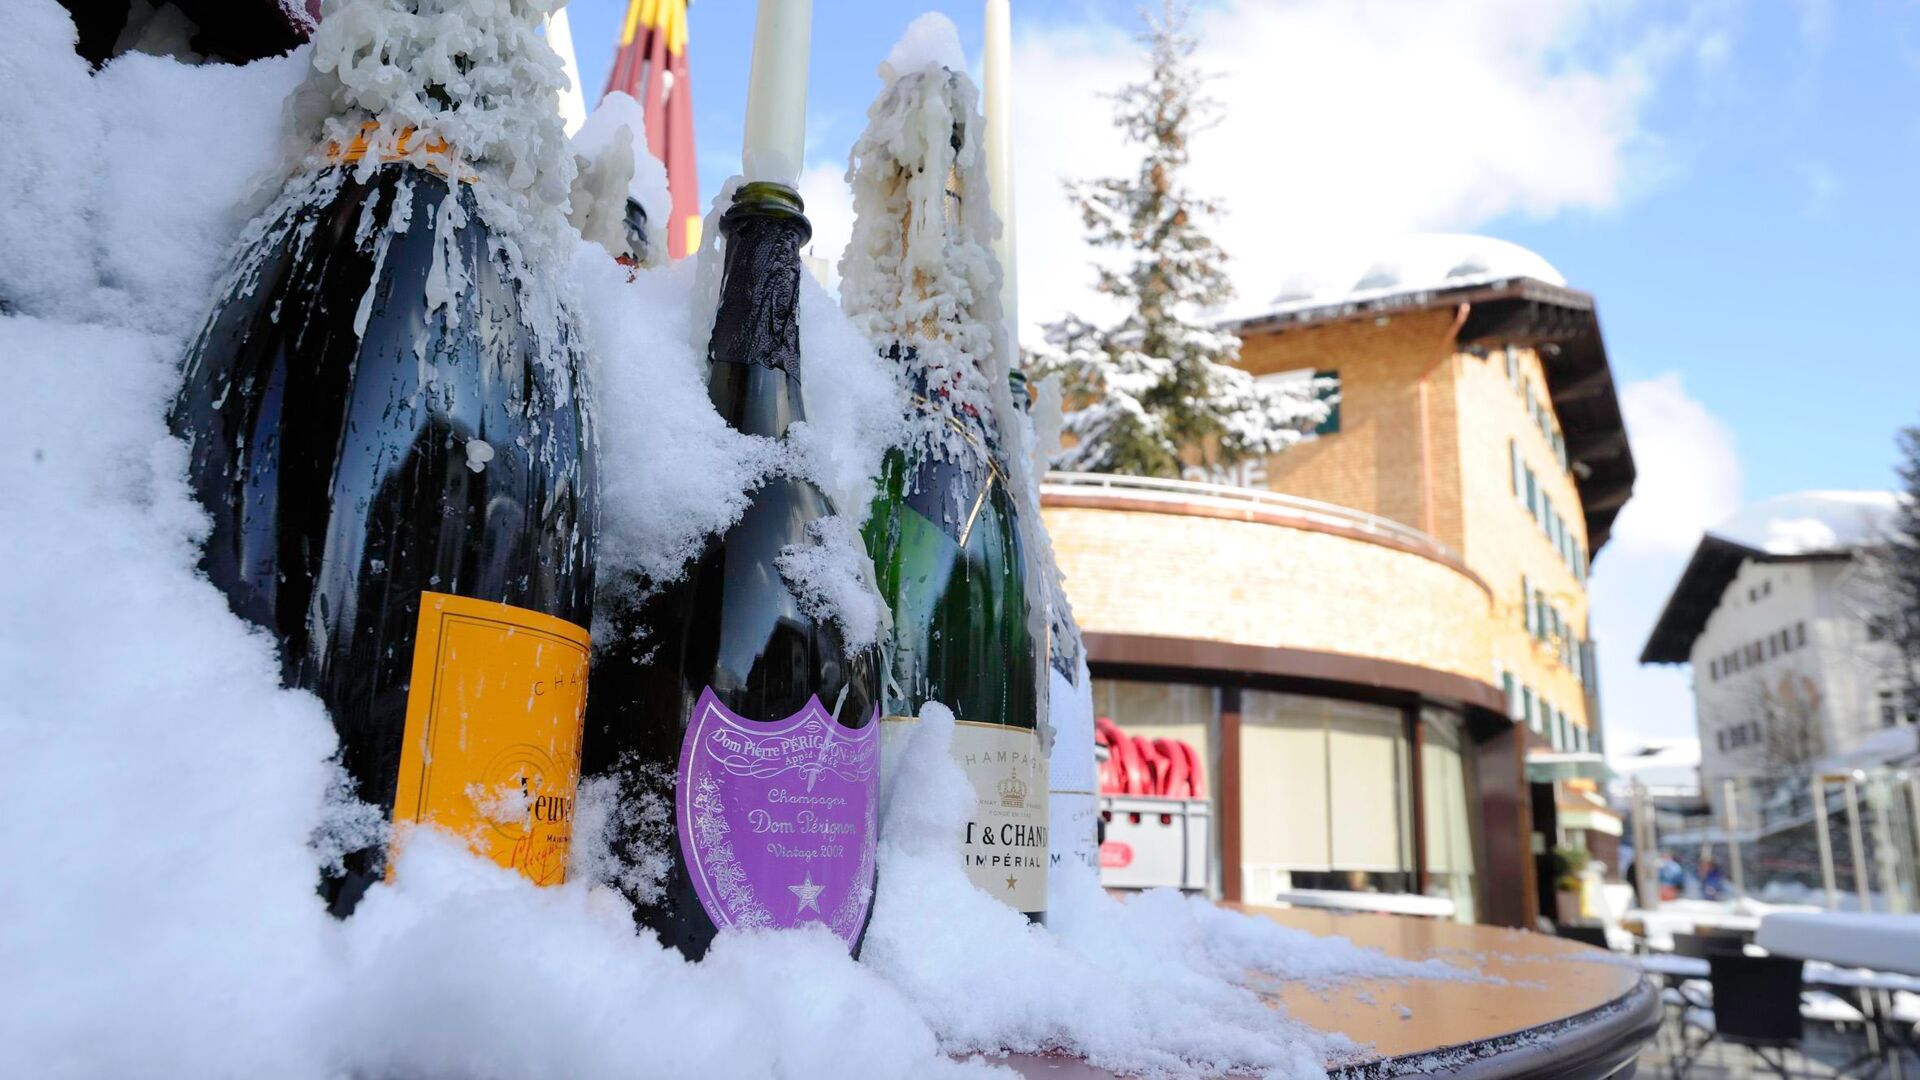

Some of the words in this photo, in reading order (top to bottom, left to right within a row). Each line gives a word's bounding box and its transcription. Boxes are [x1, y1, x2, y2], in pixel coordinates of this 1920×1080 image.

[712, 729, 741, 753] Dom
[743, 740, 780, 758] Pierre
[767, 788, 847, 810] Champagne
[747, 808, 796, 834] Dom
[796, 810, 857, 842] Pérignon
[982, 826, 996, 845] &
[766, 843, 819, 863] Vintage
[965, 852, 1041, 868] IMPÉRIAL
